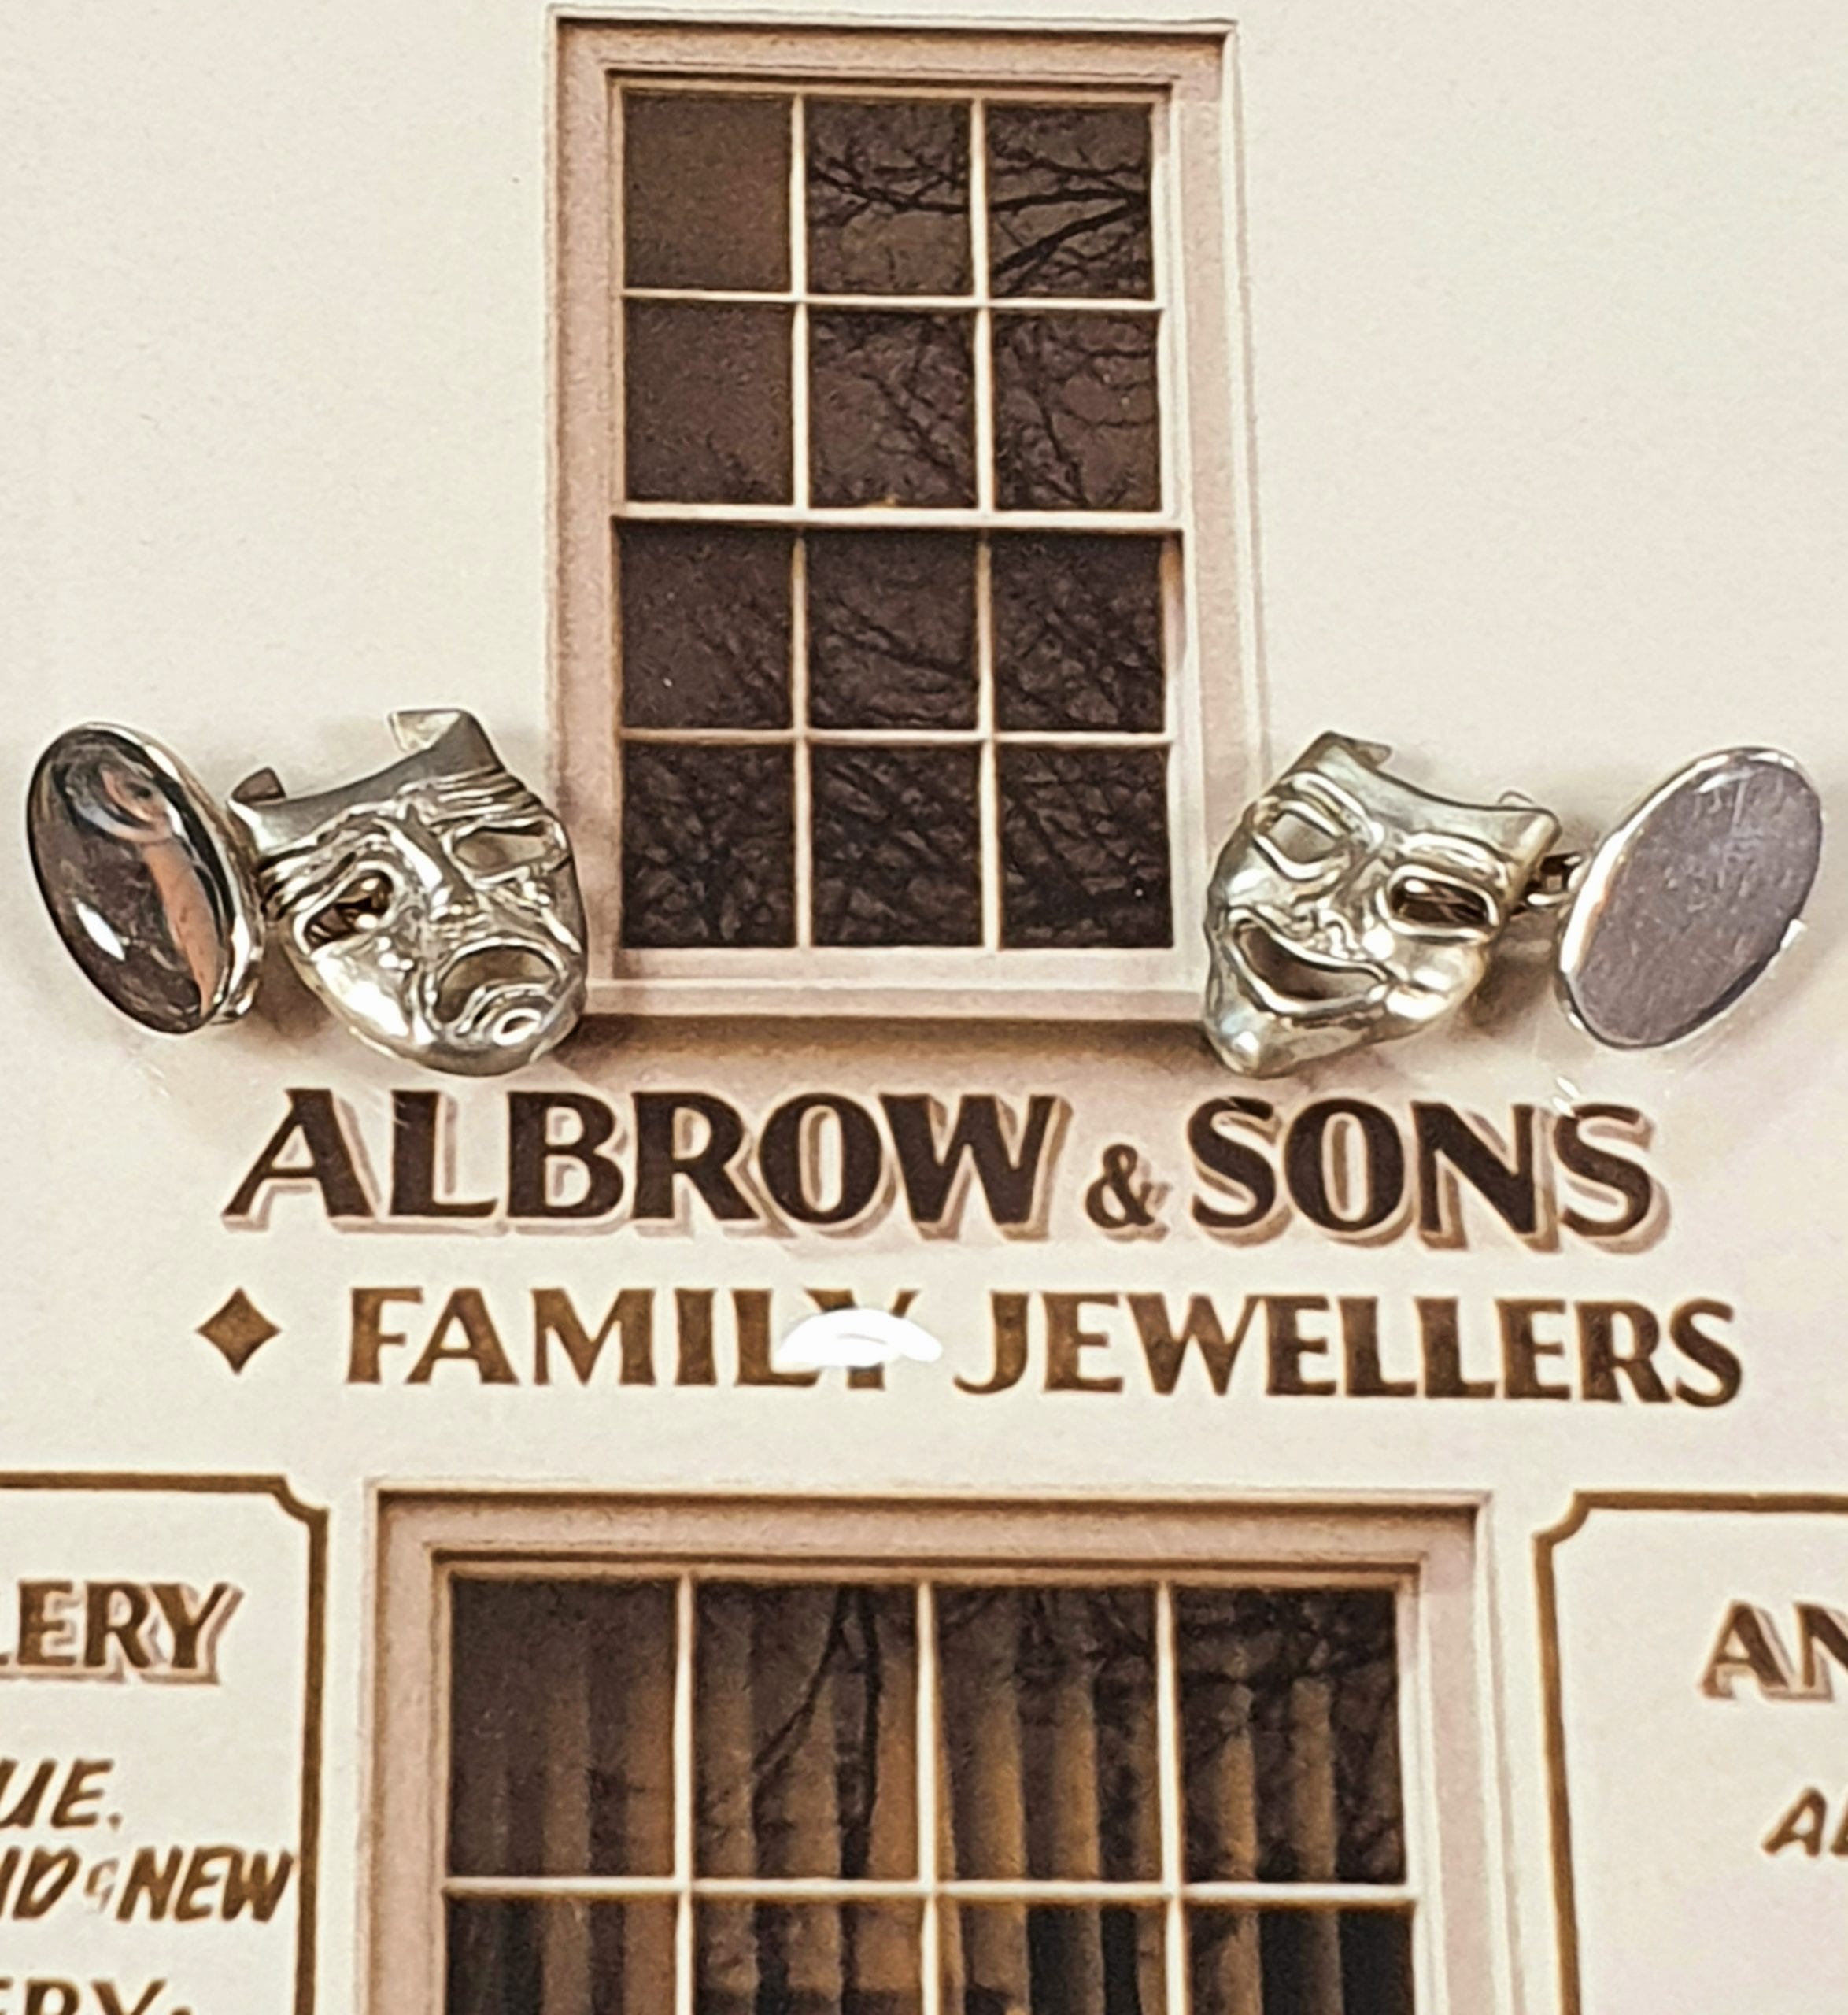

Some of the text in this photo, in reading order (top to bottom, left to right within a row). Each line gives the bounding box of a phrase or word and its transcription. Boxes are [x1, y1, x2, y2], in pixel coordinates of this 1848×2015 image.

[221, 1088, 1670, 1255] ALBROW & SONS
[953, 1292, 1743, 1407] JEWELLERS
[0, 1578, 243, 1685] ERY
[116, 1845, 295, 1923] NEW
